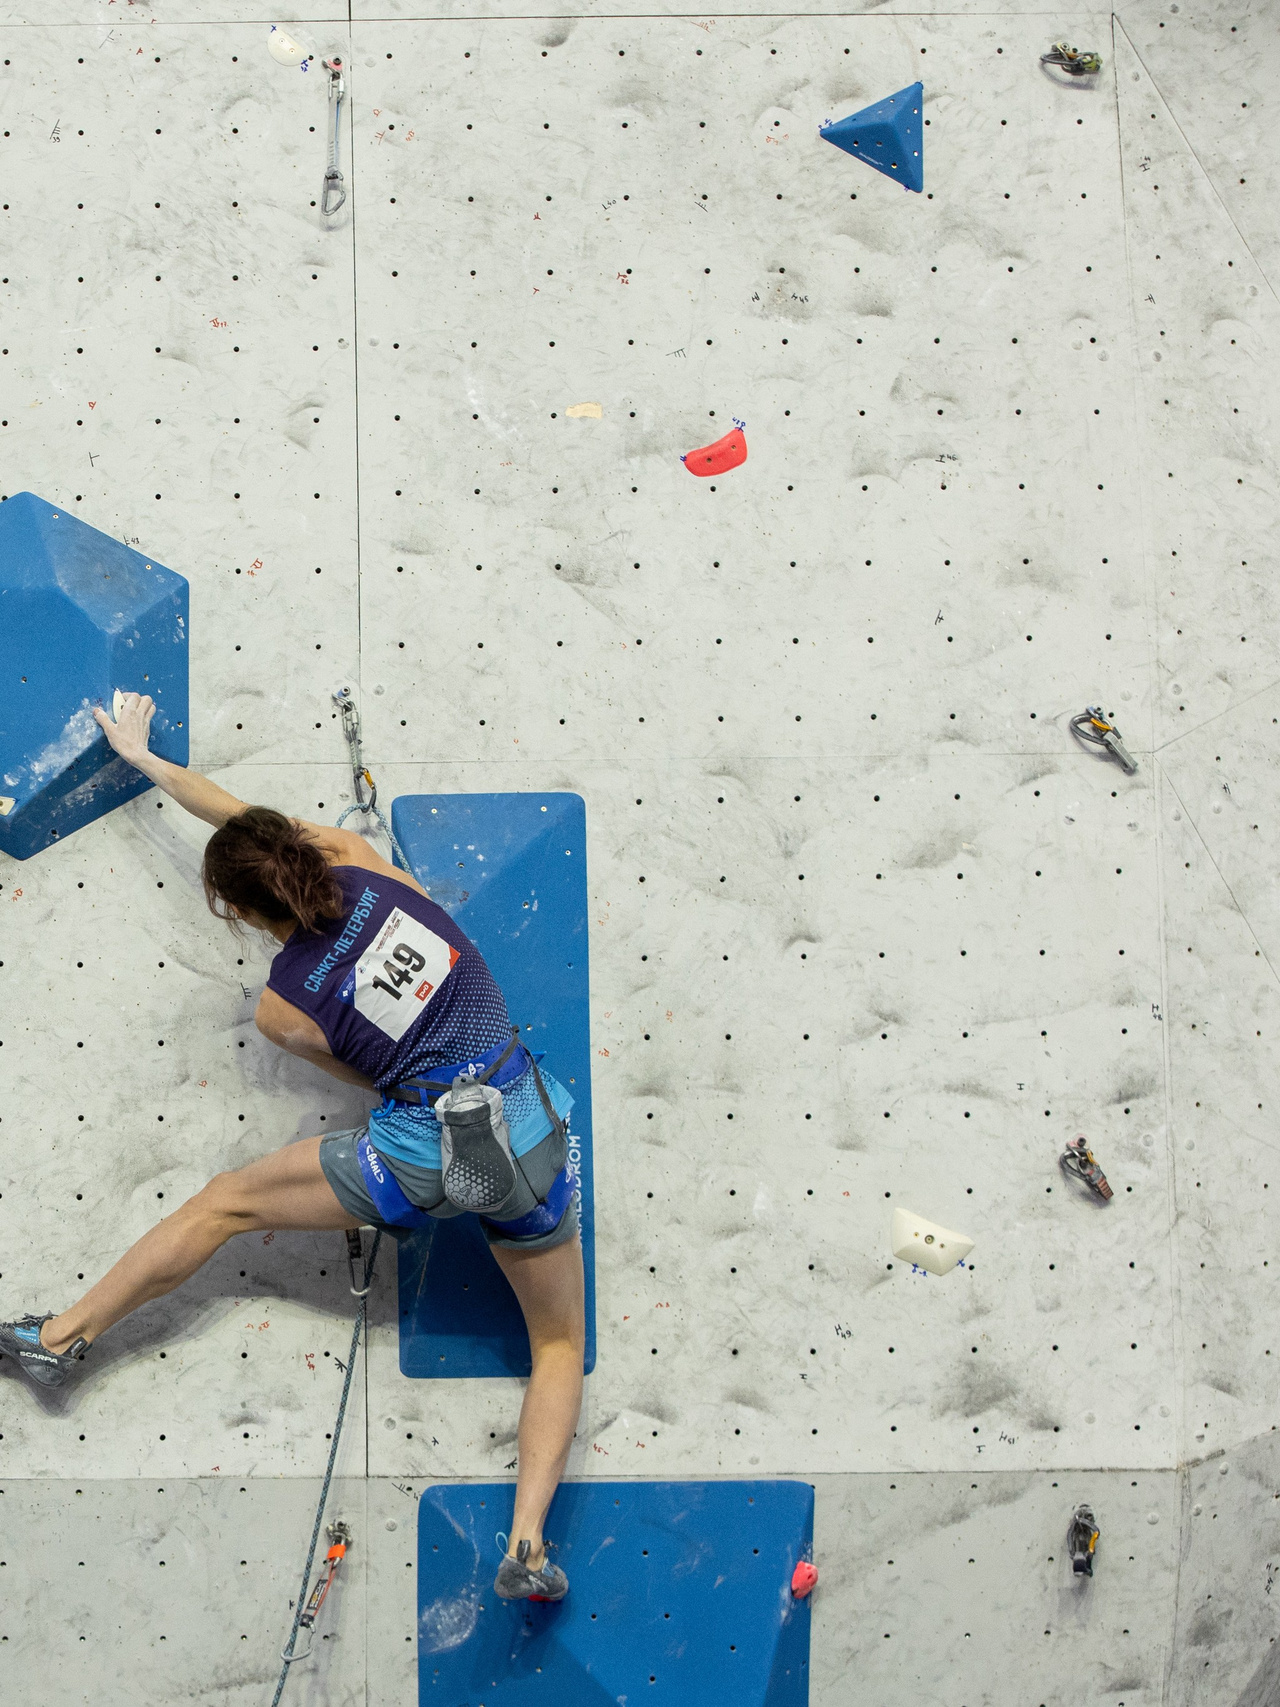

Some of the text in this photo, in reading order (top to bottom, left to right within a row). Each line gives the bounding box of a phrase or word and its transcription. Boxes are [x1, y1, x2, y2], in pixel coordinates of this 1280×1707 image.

[303, 886, 380, 993] САНКТ-ПЕТЕРБУРГ
[371, 942, 426, 1001] 149
[19, 1351, 58, 1365] SCARPA
